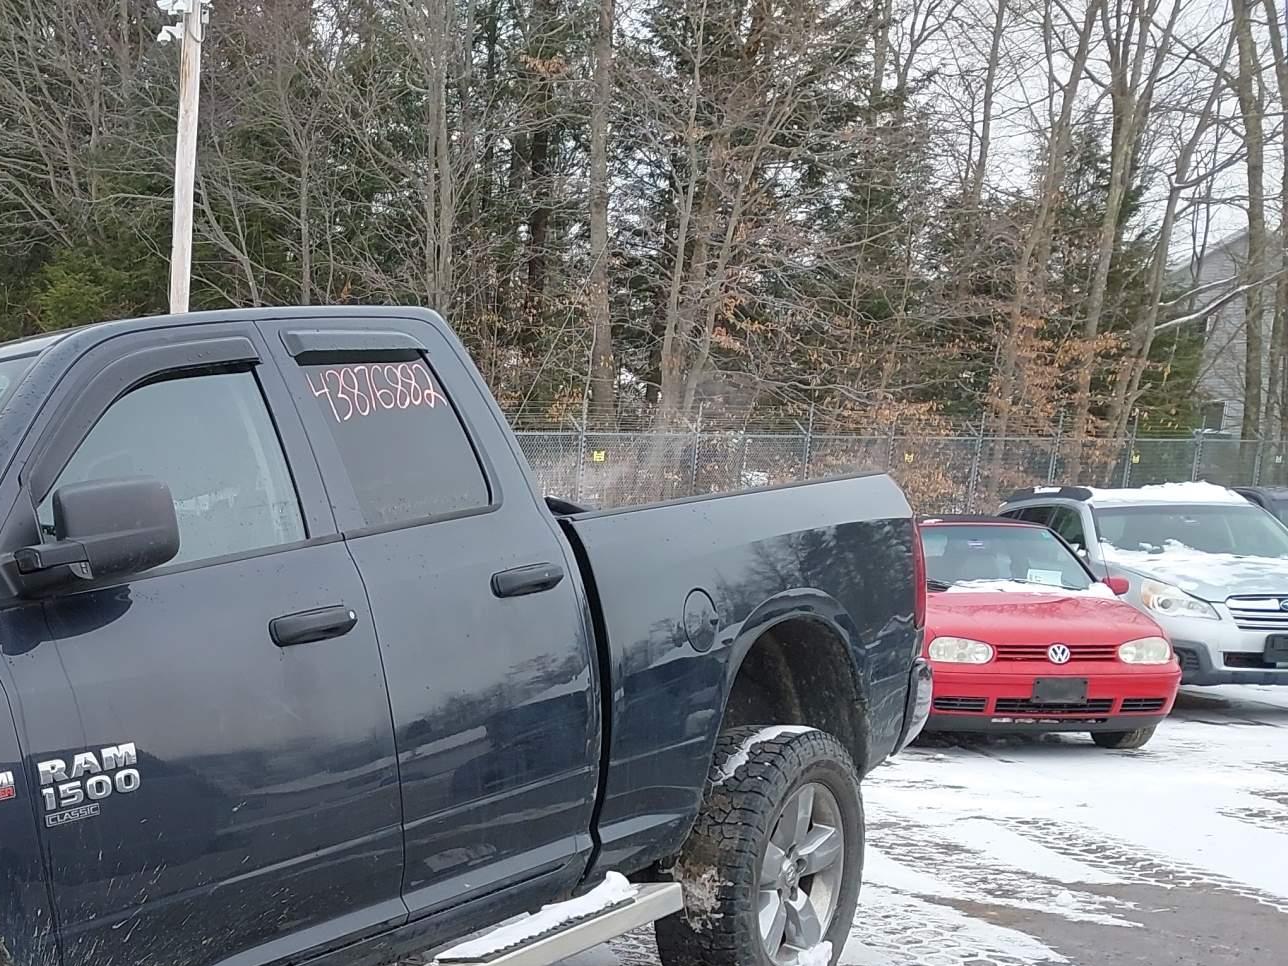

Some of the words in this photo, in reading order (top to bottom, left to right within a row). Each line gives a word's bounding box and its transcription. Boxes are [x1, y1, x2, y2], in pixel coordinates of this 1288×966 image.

[305, 363, 448, 423] 43876882
[37, 742, 138, 785] RAM
[41, 768, 141, 811] 1500
[48, 804, 99, 826] CLASSIC
